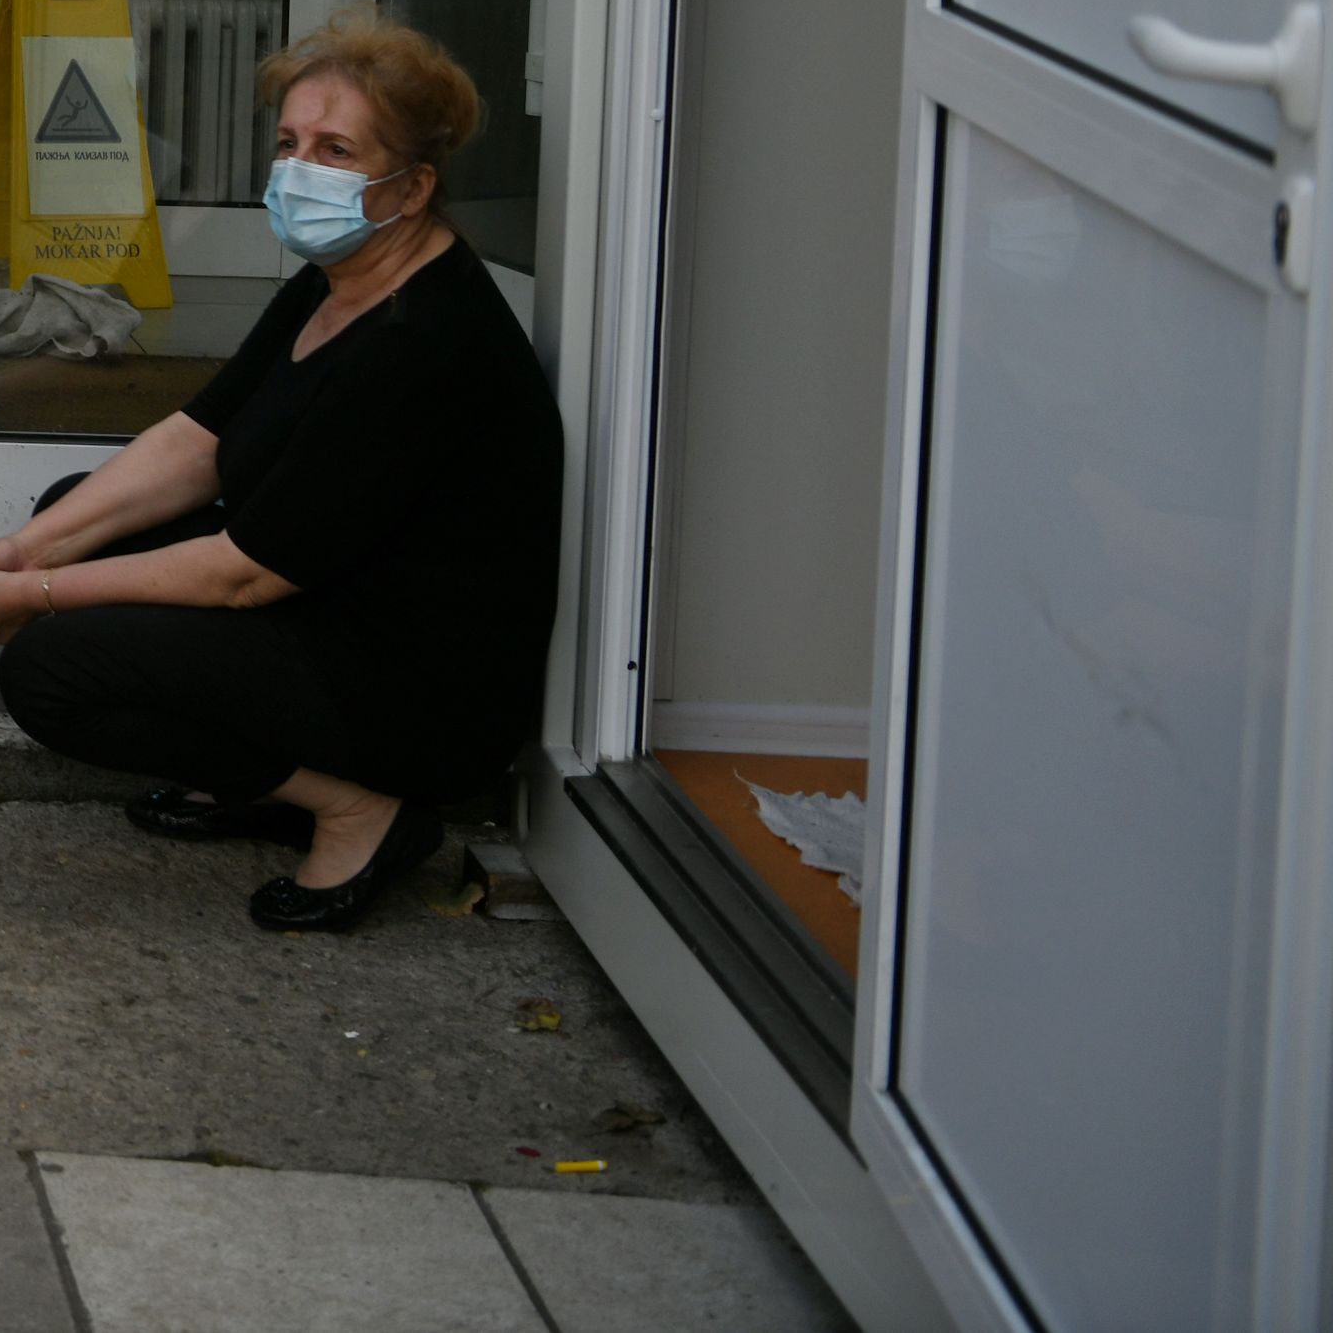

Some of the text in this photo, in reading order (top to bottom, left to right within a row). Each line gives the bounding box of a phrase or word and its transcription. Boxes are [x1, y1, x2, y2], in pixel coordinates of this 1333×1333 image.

[35, 151, 130, 162] ПАЖЊА КЛИЗАВ ПОД
[52, 222, 121, 241] PAŽNJA!
[35, 244, 140, 259] MOKAR POD
